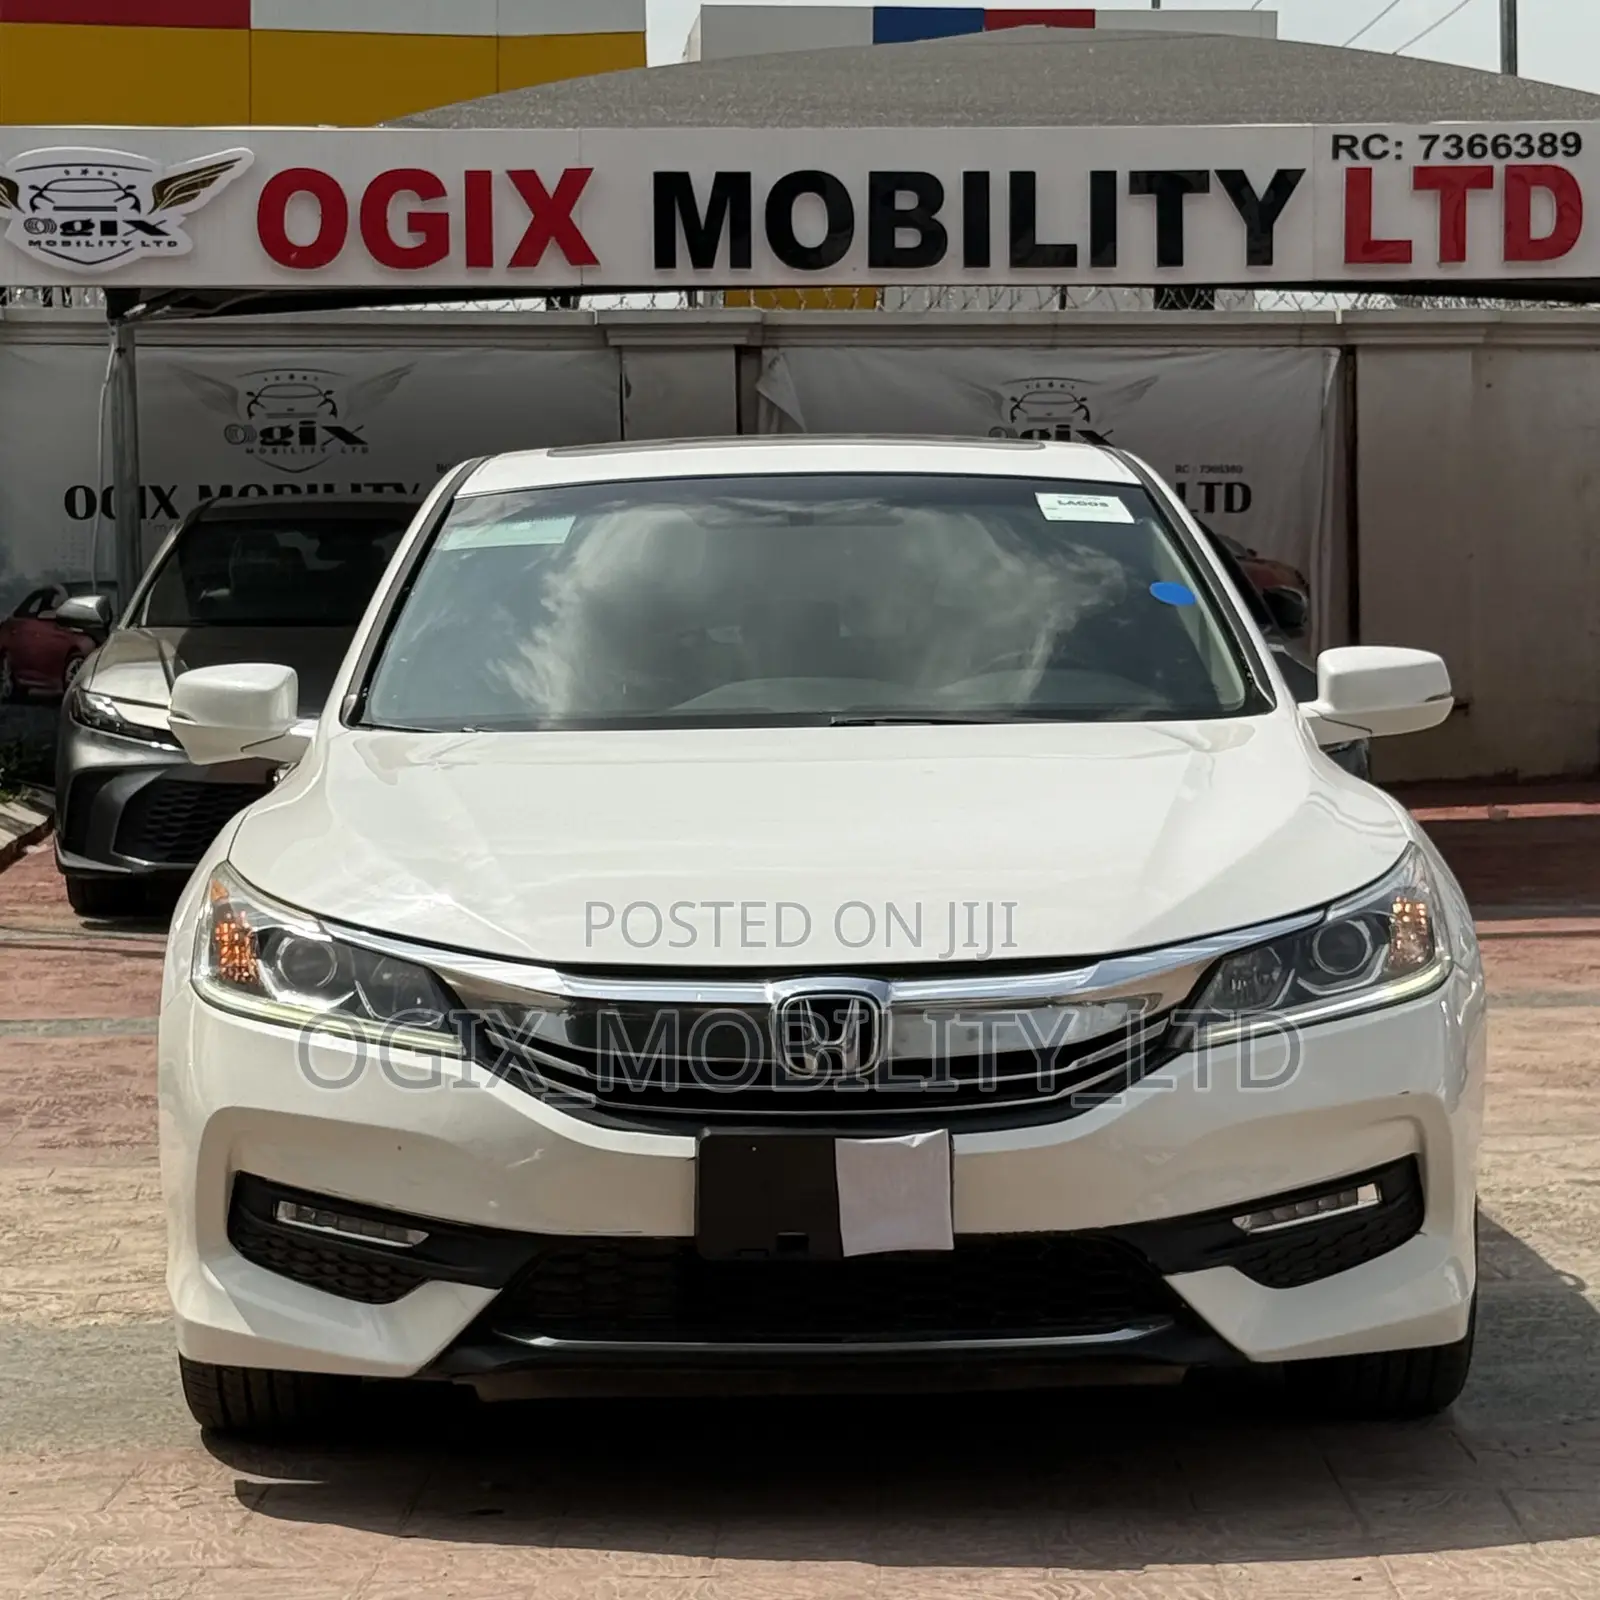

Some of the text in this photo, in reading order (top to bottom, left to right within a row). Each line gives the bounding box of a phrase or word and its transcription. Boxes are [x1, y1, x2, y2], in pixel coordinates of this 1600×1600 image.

[1331, 131, 1583, 160] RC: 7366389
[257, 164, 1583, 271] OGIX MOBILITY LTD
[1176, 482, 1252, 514] LTD
